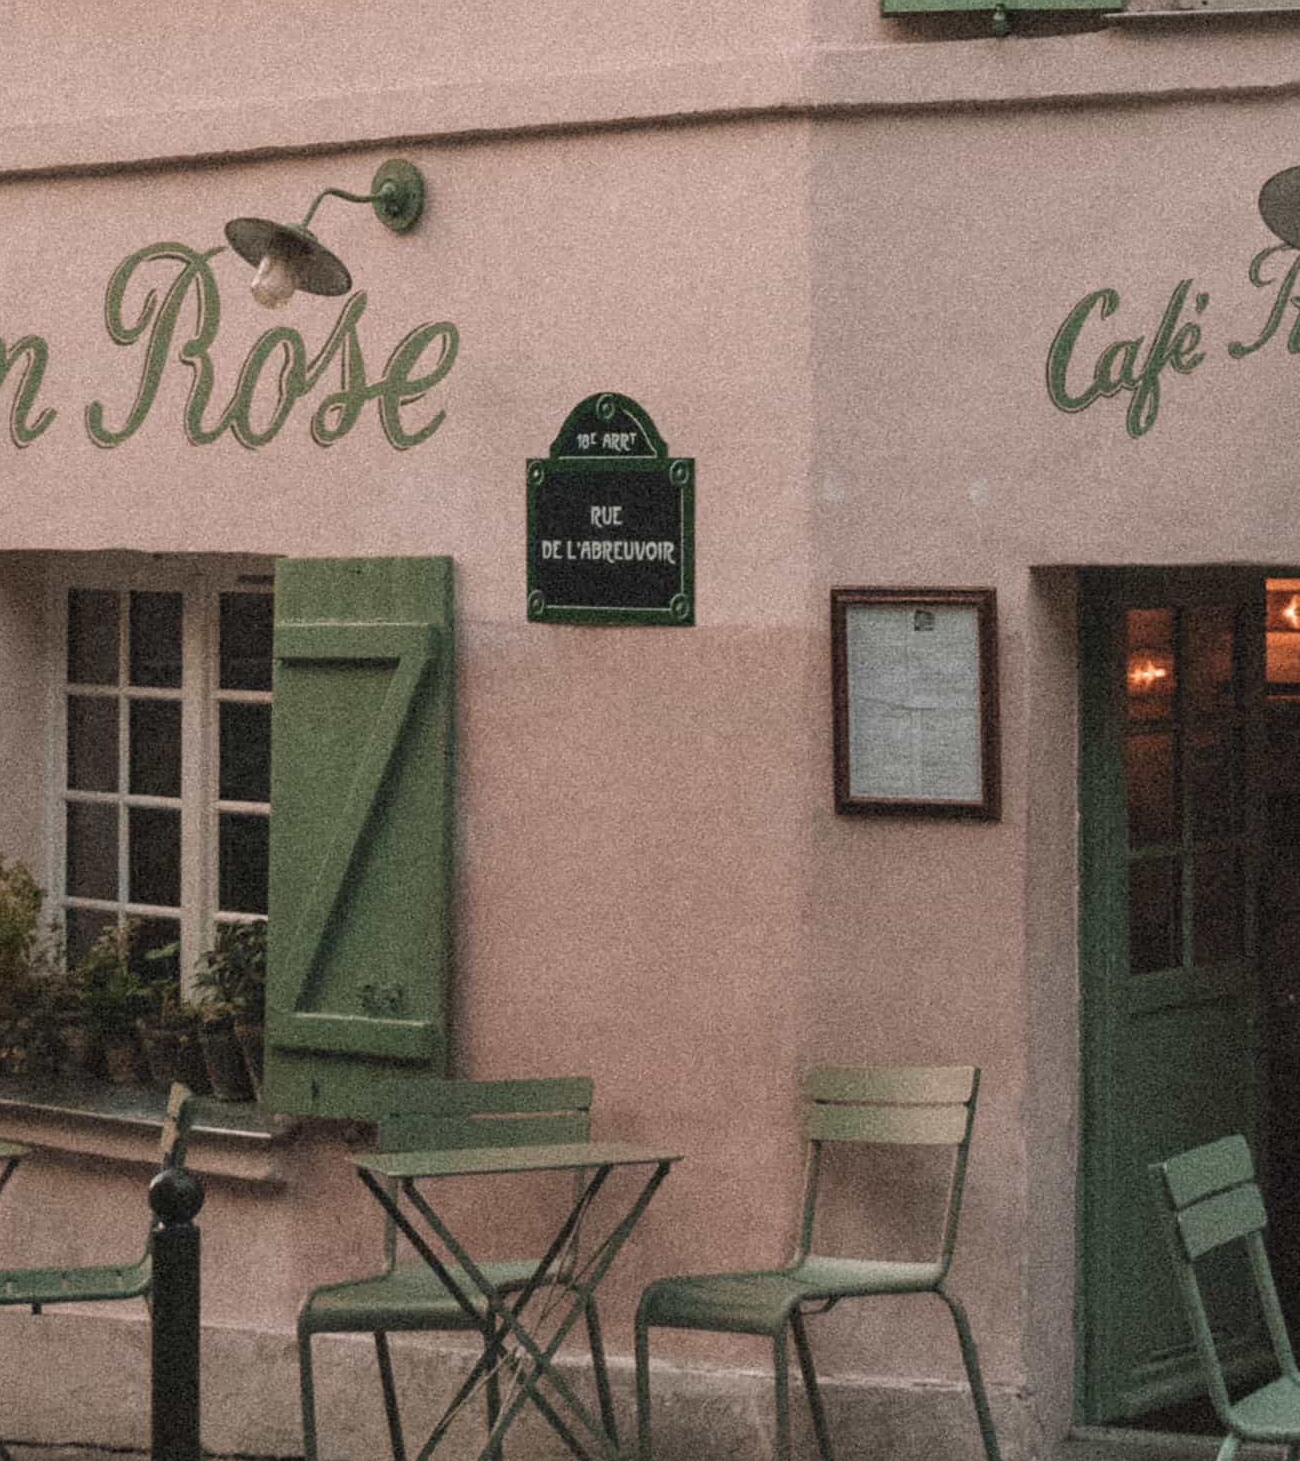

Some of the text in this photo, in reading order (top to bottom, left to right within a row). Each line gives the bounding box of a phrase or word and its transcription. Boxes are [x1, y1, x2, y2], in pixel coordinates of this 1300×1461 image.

[84, 240, 462, 451] Rose
[1046, 278, 1210, 439] Café
[541, 540, 677, 565] DE L'ABREUVOIR
[590, 505, 624, 528] RUE
